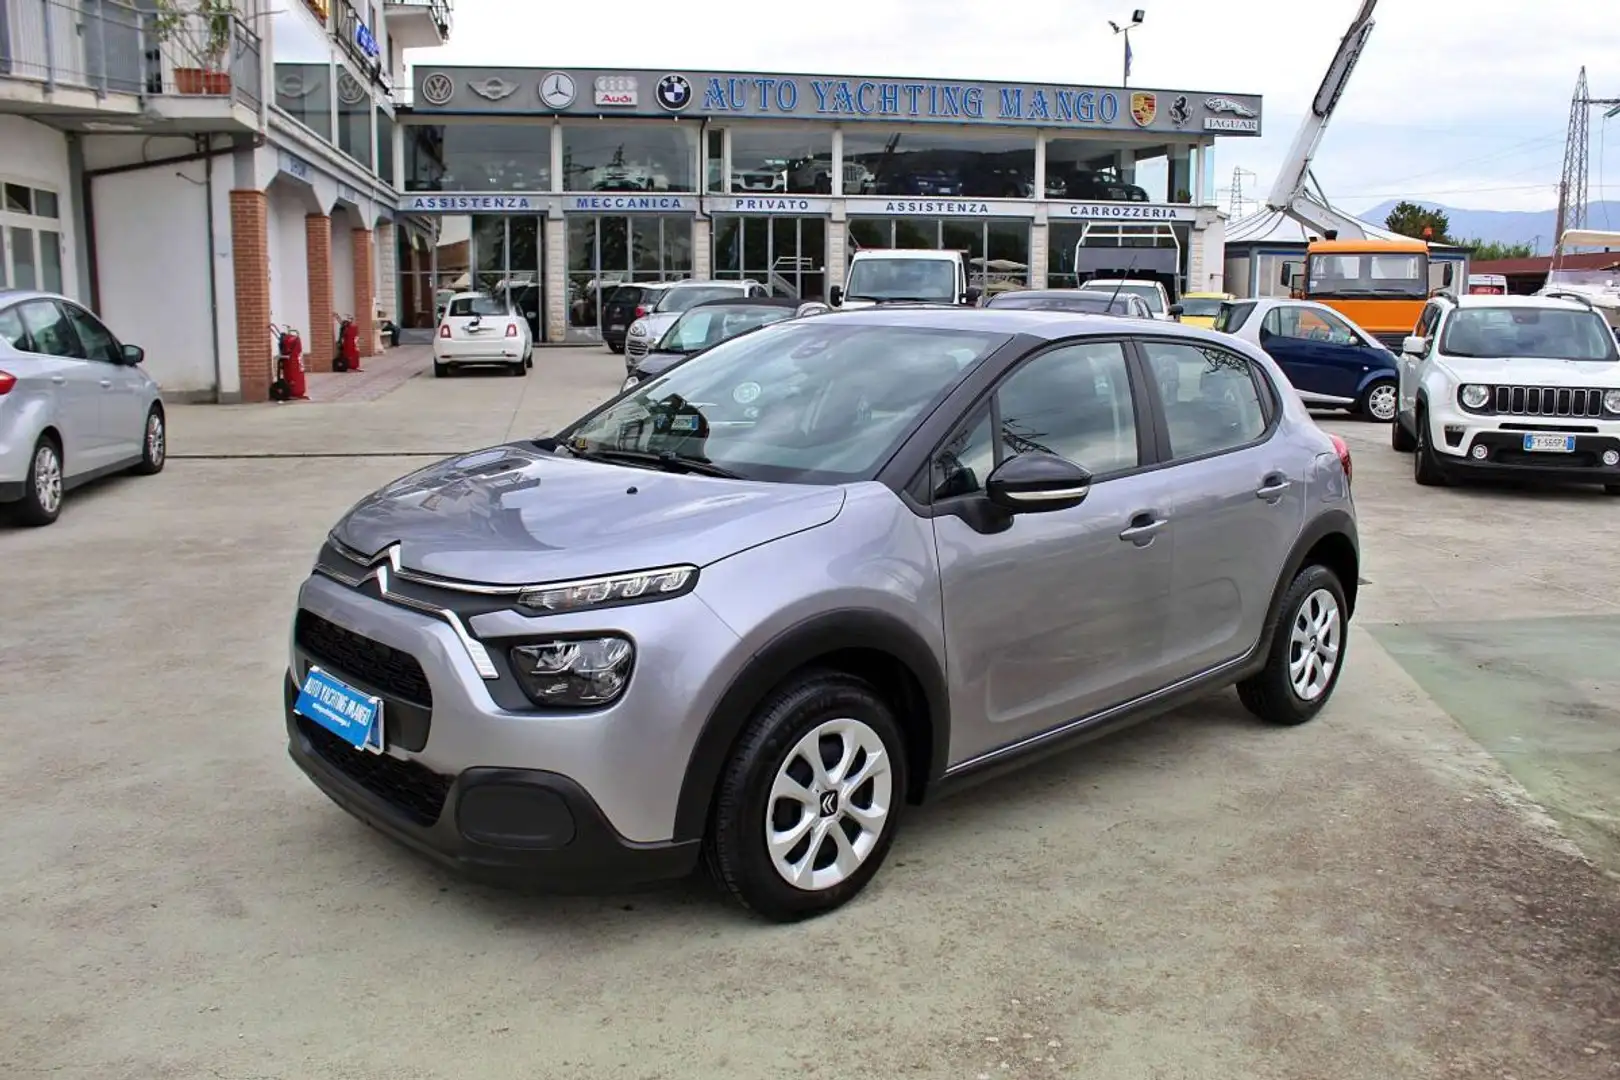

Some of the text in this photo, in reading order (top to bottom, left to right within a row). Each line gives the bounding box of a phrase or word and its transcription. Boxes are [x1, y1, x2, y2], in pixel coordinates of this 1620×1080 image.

[602, 94, 632, 103] Audi
[703, 77, 1119, 123] AUTO YACHTING MANGO
[1209, 118, 1256, 130] JAGUAR
[413, 198, 530, 209] ASSISTENZA
[576, 198, 682, 209] MECCANICA
[735, 199, 810, 211] PRIVATO
[885, 201, 989, 214] ASSISTENZA
[1069, 205, 1178, 219] CARROZZERIA
